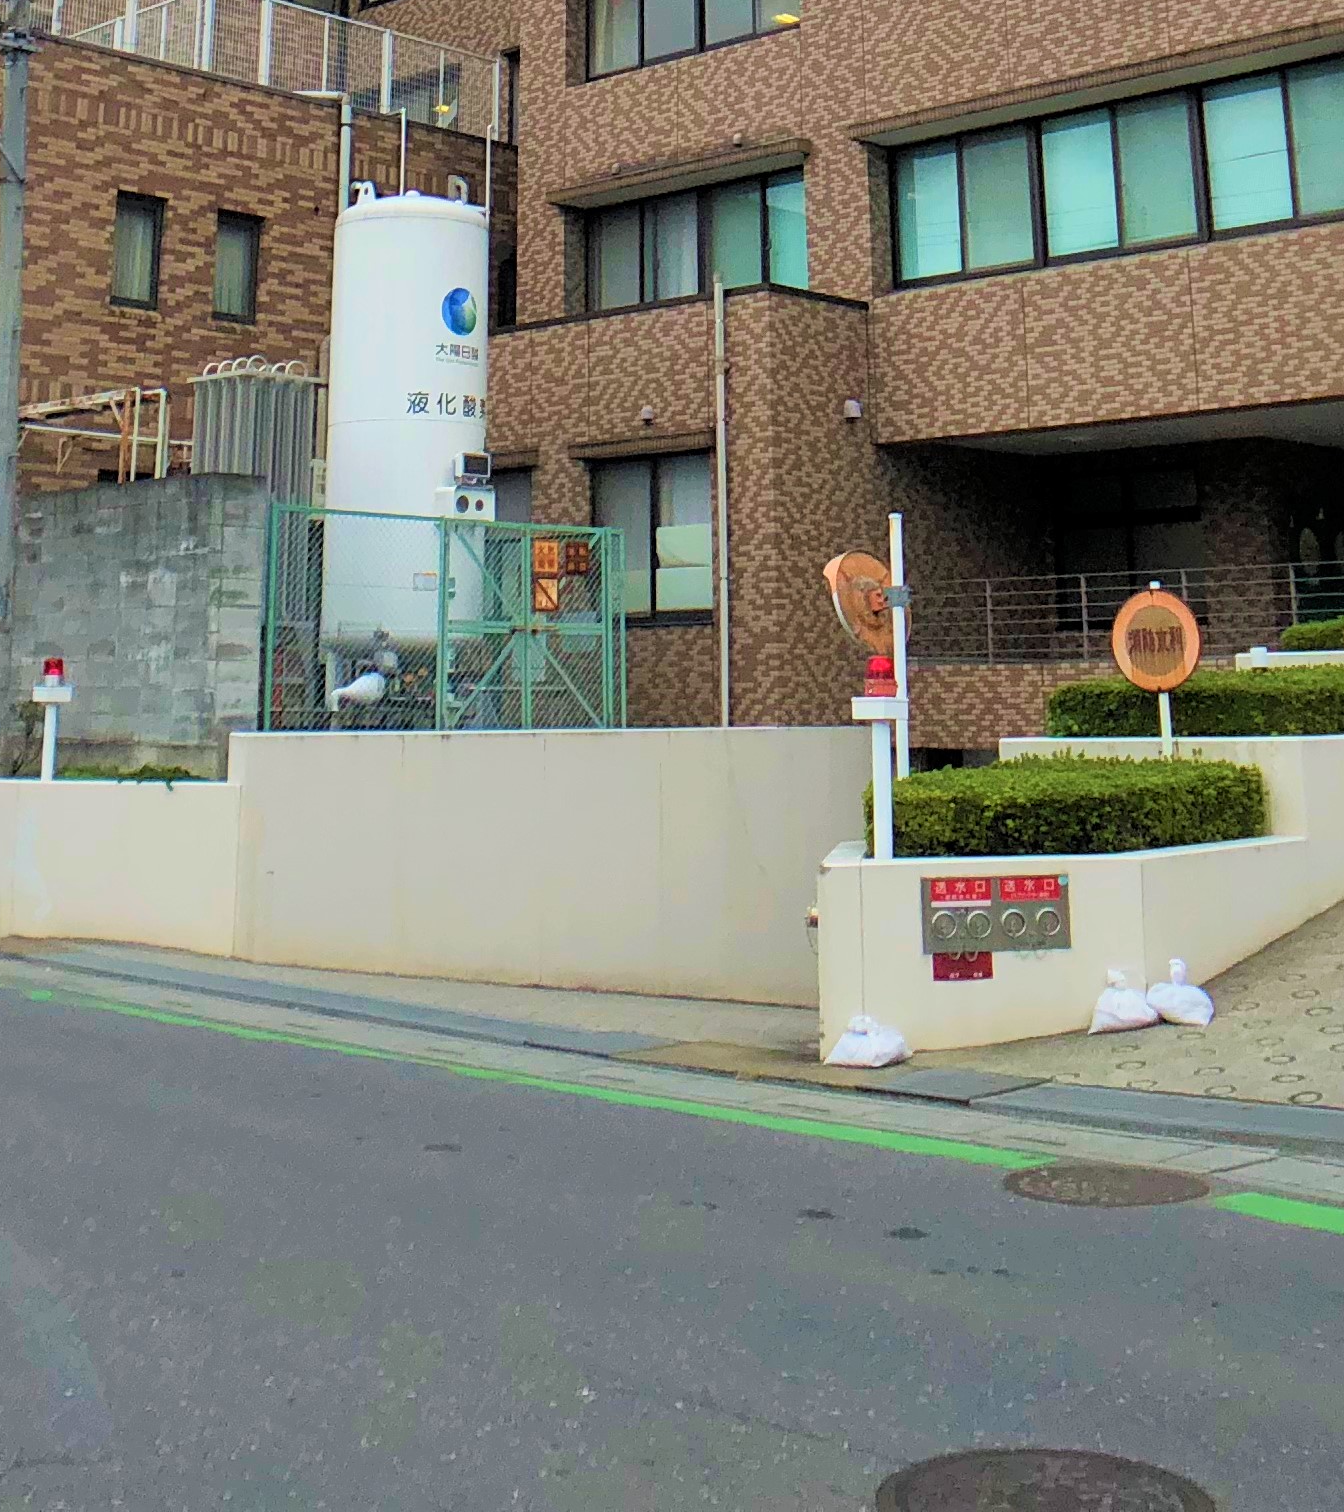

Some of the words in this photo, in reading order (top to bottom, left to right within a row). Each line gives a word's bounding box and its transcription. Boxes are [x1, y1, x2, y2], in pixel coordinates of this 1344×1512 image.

[1127, 625, 1184, 654] 消防水利
[935, 881, 986, 894] 送水口
[1004, 878, 1055, 892] 送水口
